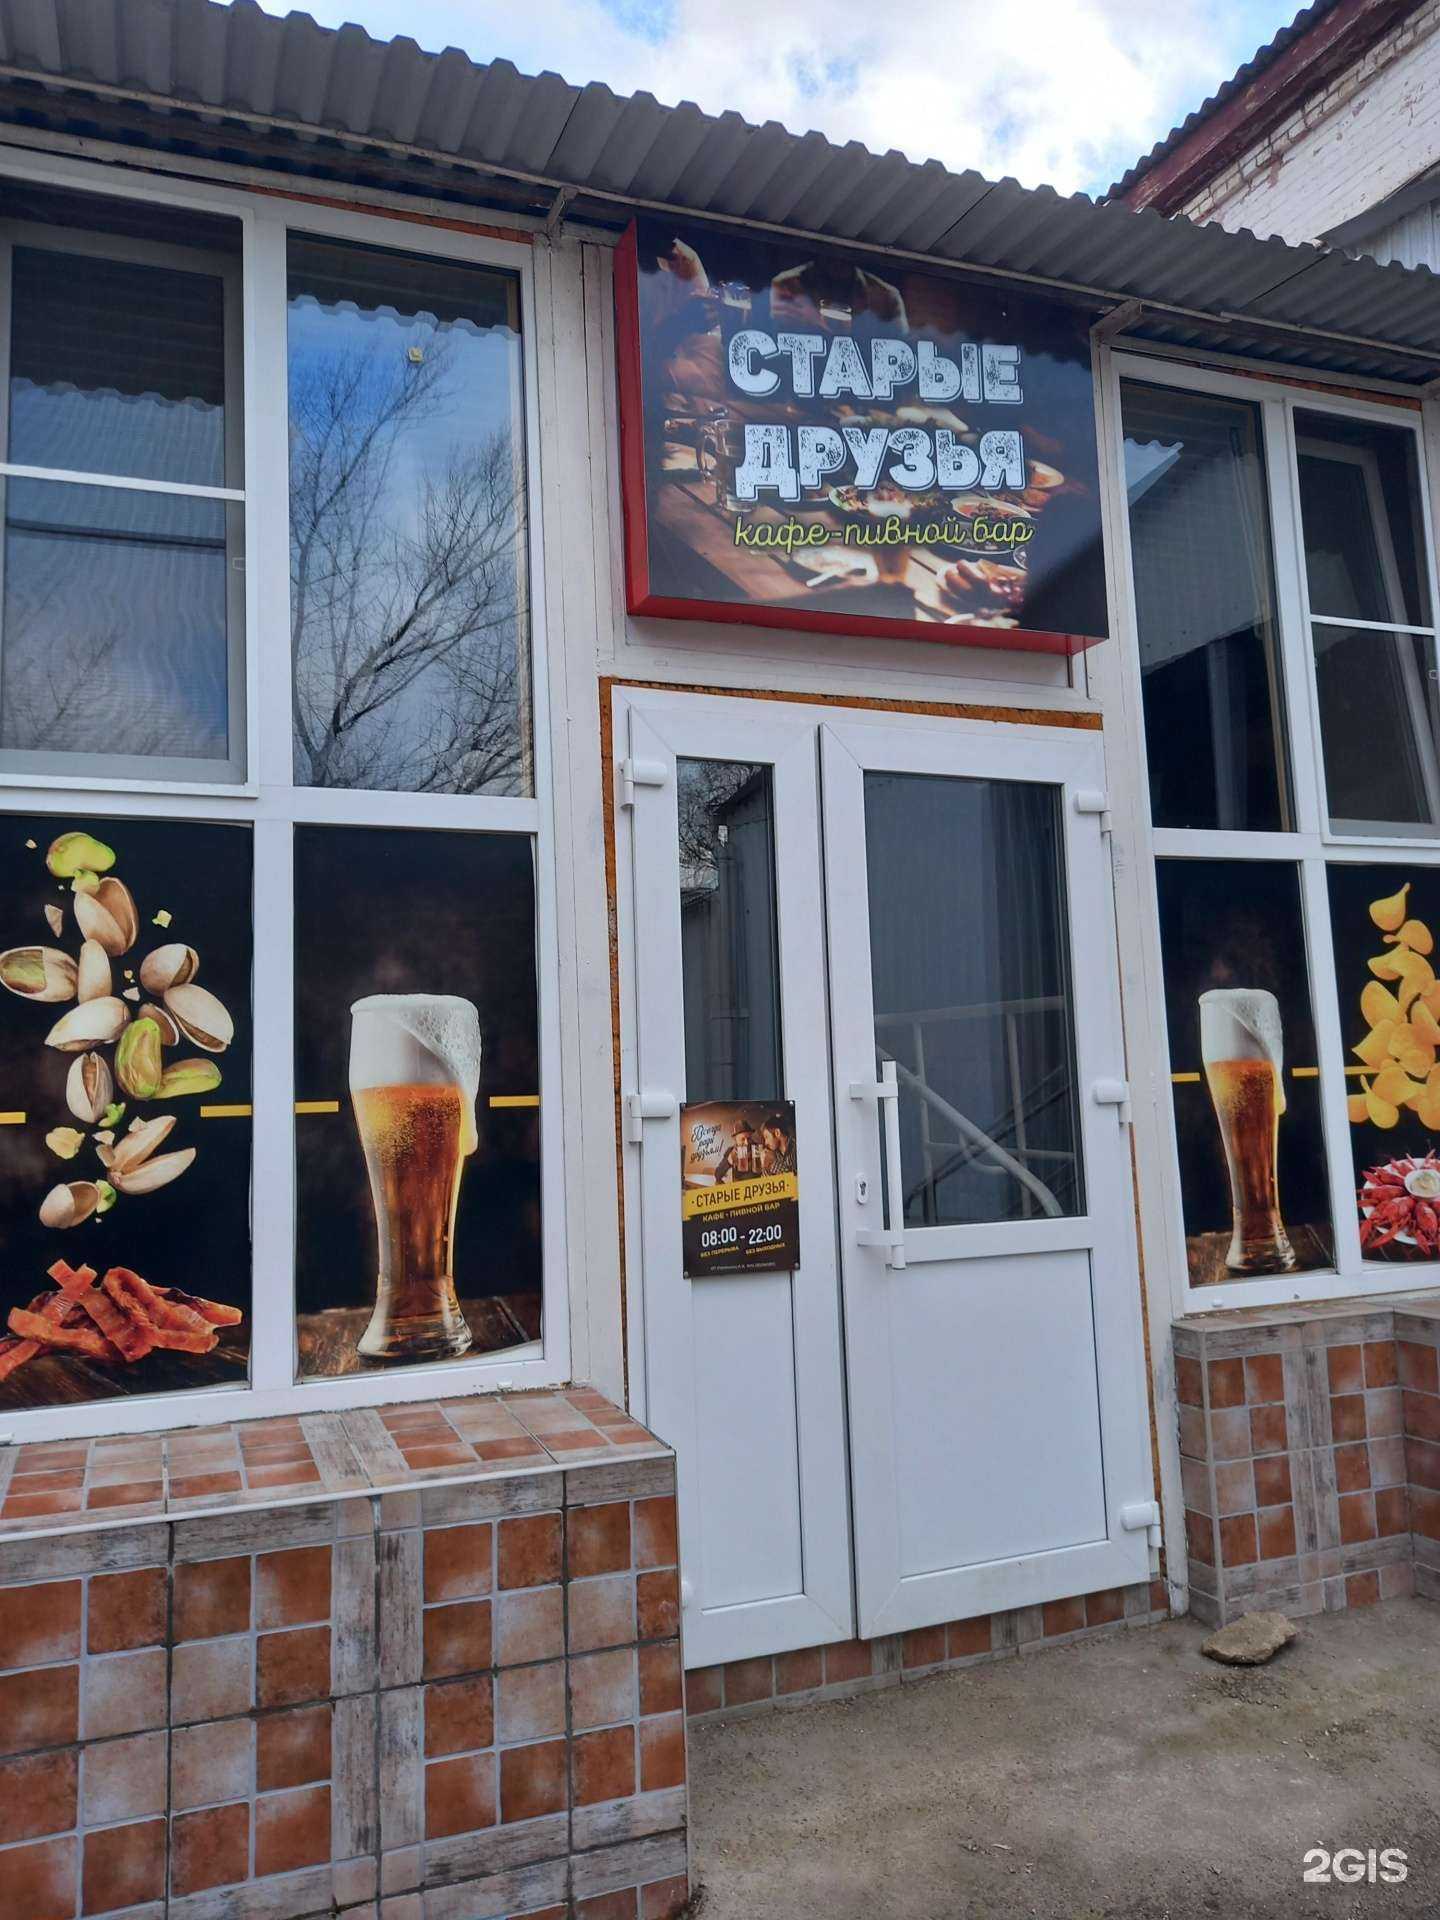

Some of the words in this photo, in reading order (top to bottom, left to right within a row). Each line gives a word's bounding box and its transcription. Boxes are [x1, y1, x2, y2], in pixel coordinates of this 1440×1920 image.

[728, 329, 1023, 404] СТАРЫЕ
[735, 424, 1026, 502] ДРУЗЬЯ
[734, 516, 967, 553] кафе-пивной
[972, 516, 1035, 549] бар
[696, 1187, 740, 1208] СТАРЫЕ
[744, 1180, 786, 1201] ДРУЗЬЯ
[702, 1211, 724, 1223] КАФЕ
[730, 1205, 763, 1218] ПИВНОЙ
[765, 1202, 781, 1213] БАР
[701, 1226, 738, 1248] 08:00
[748, 1224, 782, 1245] 22:00
